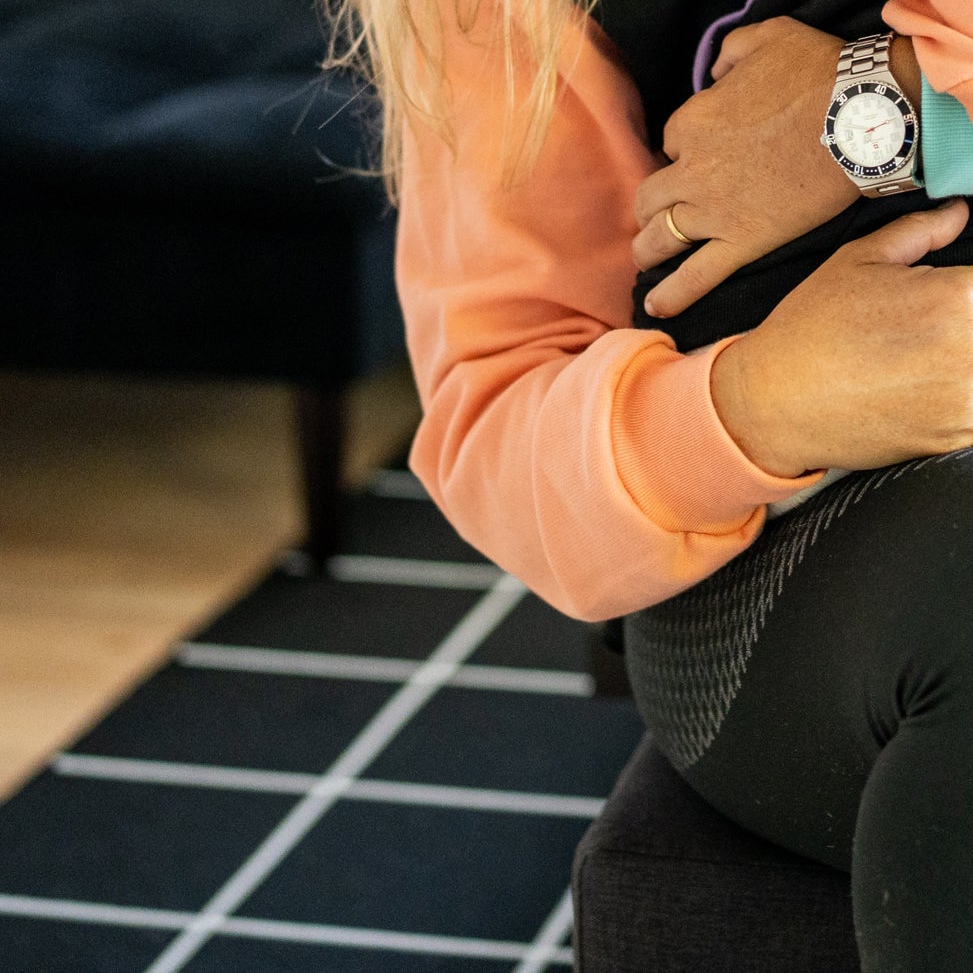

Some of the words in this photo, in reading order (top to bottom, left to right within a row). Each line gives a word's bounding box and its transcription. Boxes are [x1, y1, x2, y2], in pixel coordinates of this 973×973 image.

[875, 84, 887, 94] 40
[836, 93, 848, 106] 30
[903, 114, 914, 126] 50
[827, 134, 836, 145] 20
[854, 165, 864, 175] 10
